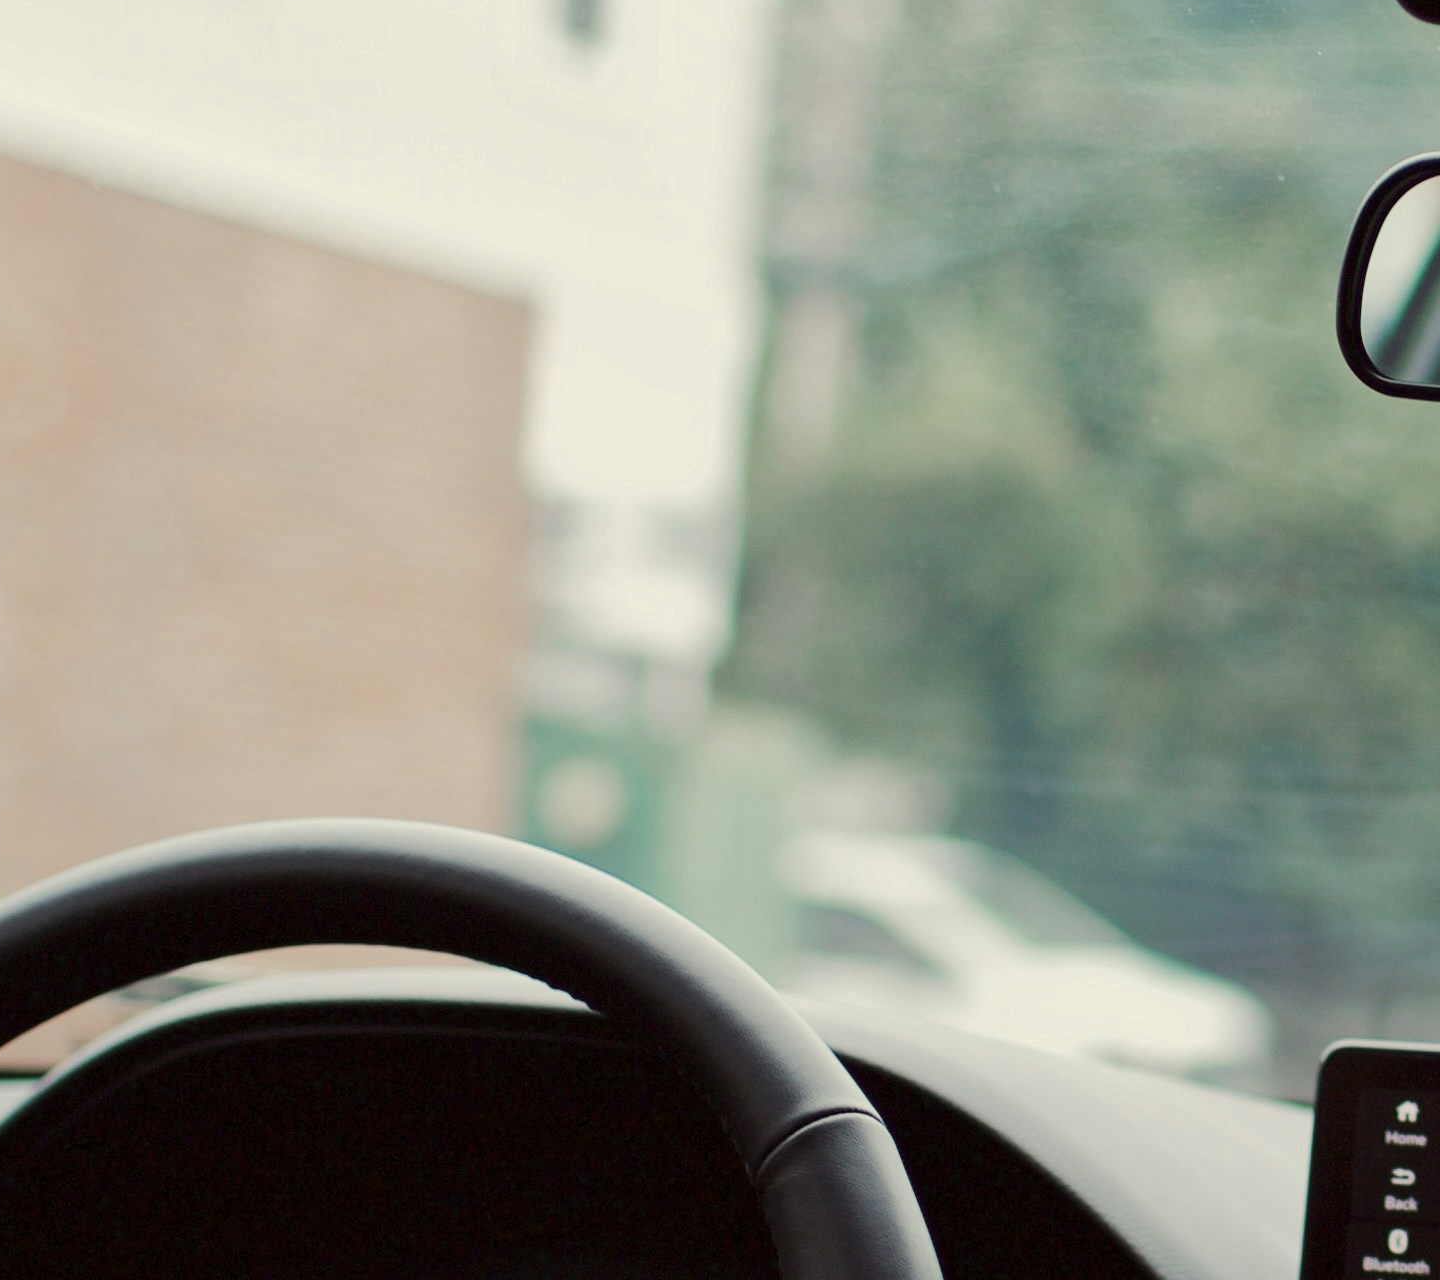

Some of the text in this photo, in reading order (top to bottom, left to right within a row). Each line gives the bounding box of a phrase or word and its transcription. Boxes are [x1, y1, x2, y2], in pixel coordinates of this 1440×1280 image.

[1385, 1130, 1428, 1147] Home
[1384, 1195, 1418, 1212] Back
[1362, 1255, 1431, 1275] Bluetooth
